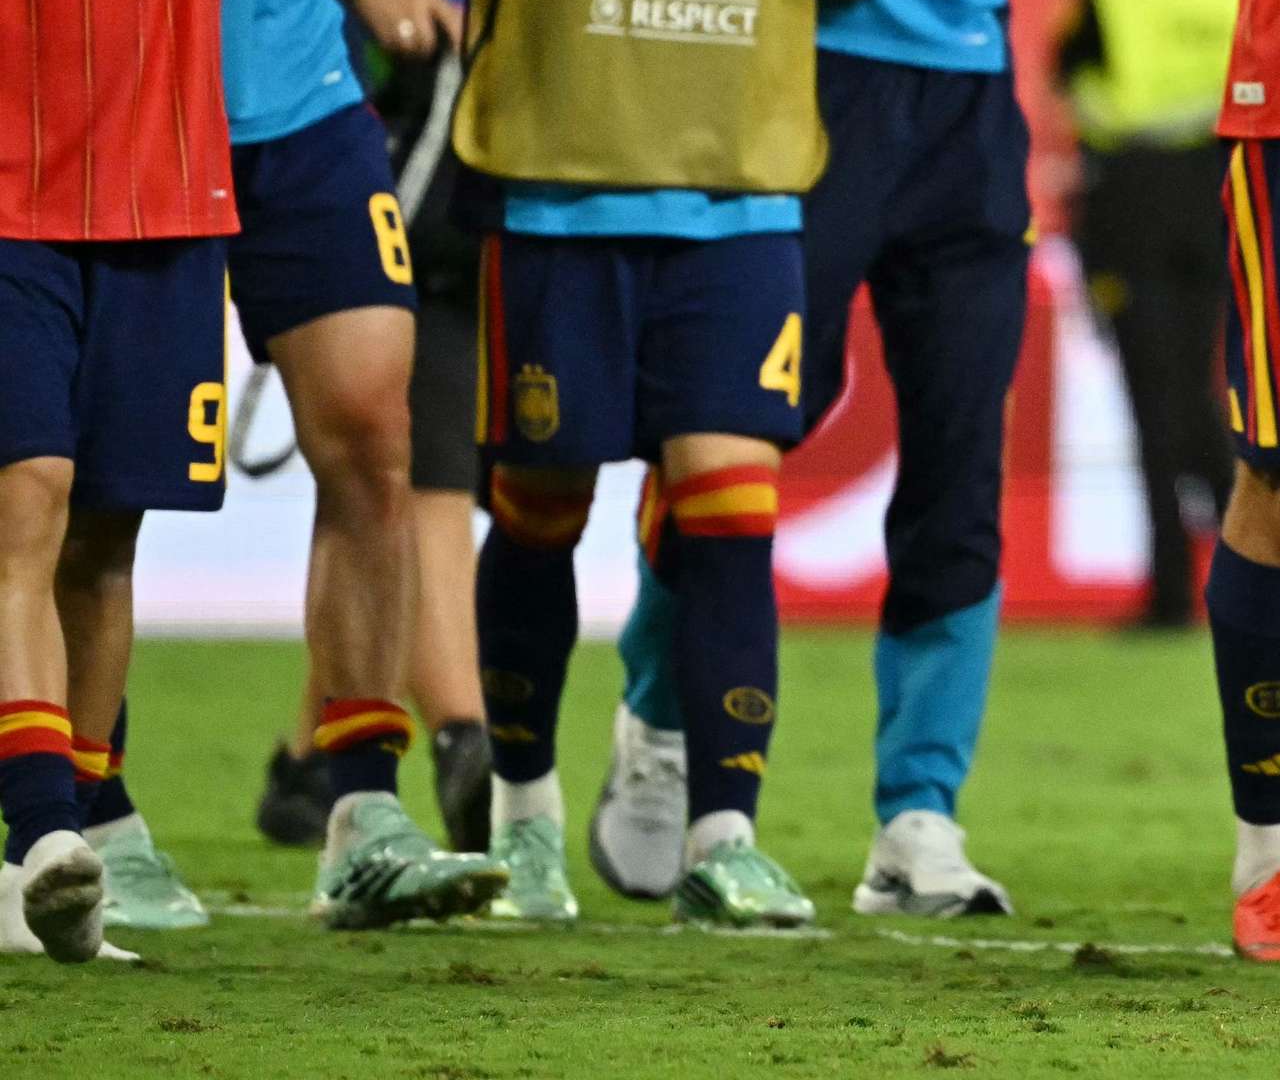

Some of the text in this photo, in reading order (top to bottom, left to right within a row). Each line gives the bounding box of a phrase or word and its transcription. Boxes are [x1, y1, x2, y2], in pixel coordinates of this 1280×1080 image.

[369, 192, 413, 285] 8
[759, 311, 802, 408] 4
[187, 382, 228, 483] 9
